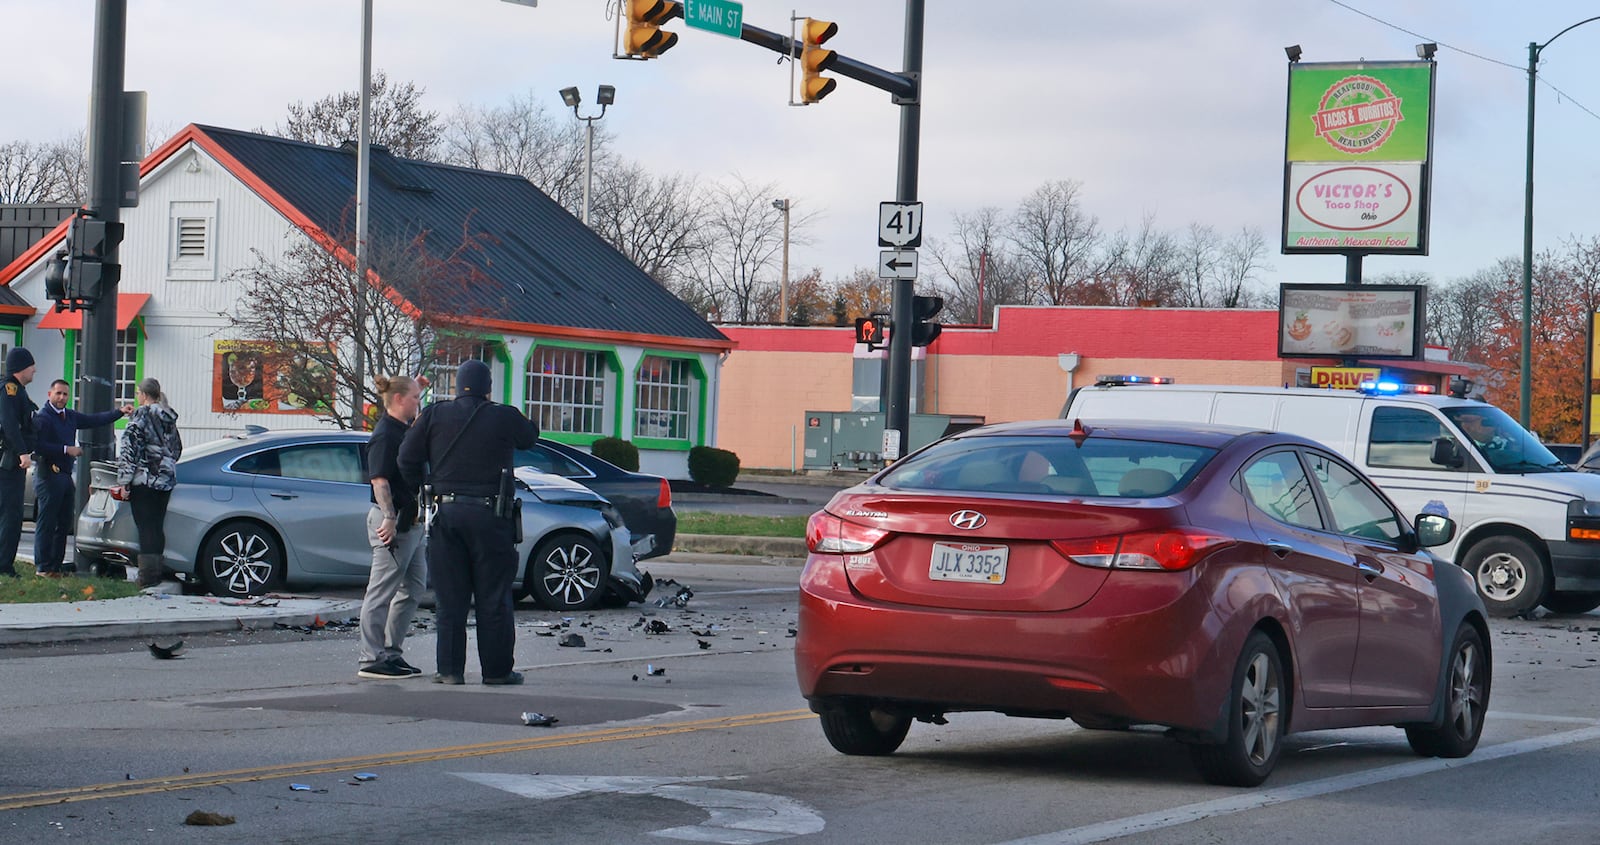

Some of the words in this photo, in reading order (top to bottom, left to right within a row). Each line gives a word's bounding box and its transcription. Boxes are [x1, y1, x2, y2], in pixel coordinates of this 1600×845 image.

[688, 0, 694, 18] E
[698, 3, 722, 25] MAIN
[727, 10, 739, 28] ST
[1333, 84, 1350, 100] REAL
[1322, 110, 1346, 128] TACOS
[1348, 110, 1355, 123] &
[1358, 102, 1394, 122] BURRITOS
[1338, 136, 1357, 148] REAL
[1314, 184, 1392, 198] VICTOR'S
[1324, 200, 1351, 209] Taco
[1354, 200, 1380, 212] Shop
[886, 210, 913, 234] 41
[1360, 212, 1378, 221] Ohio
[1296, 236, 1340, 246] Authentic
[1342, 236, 1382, 246] Mexican
[1385, 236, 1409, 246] Food
[1317, 372, 1374, 386] DRIVE
[846, 510, 888, 518] ELANTRA
[962, 544, 980, 552] OHIO
[936, 552, 962, 572] JLX
[966, 554, 1002, 574] 3352
